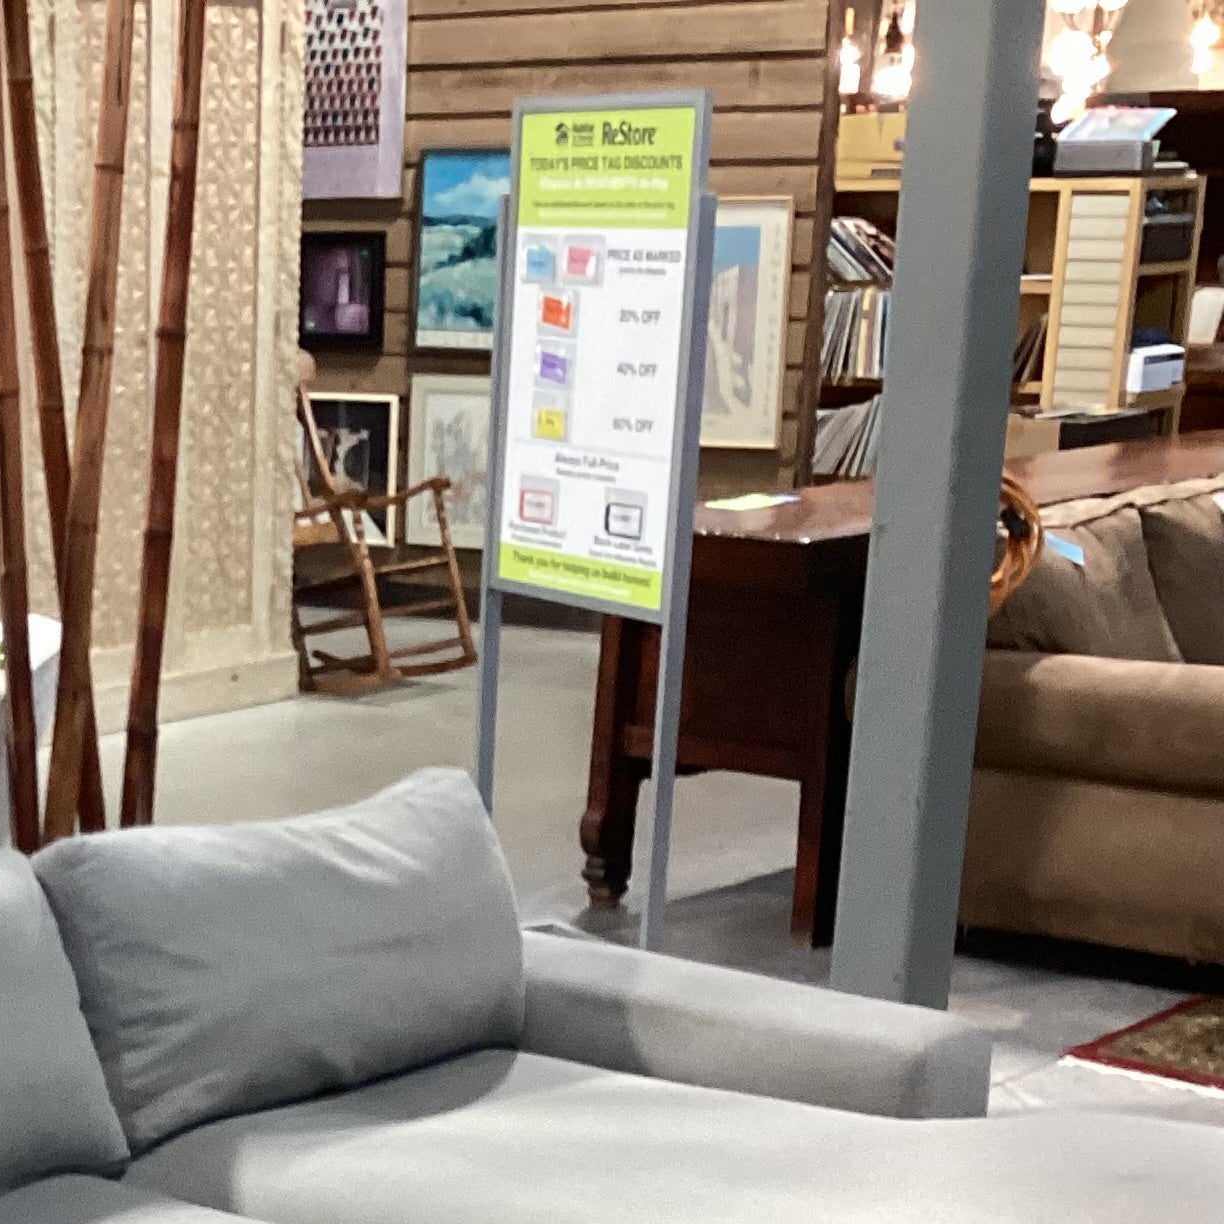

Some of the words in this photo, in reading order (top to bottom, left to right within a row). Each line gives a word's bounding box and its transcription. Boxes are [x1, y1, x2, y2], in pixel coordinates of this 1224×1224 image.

[602, 121, 656, 146] ReStore
[530, 157, 569, 171] TODAY'S
[572, 156, 599, 170] PRICE
[602, 156, 622, 170] TAG
[624, 155, 683, 170] DISCOUNTS
[608, 249, 630, 261] PRICE
[633, 250, 643, 261] AS
[646, 250, 681, 263] MARKED
[642, 311, 661, 324] OFF
[617, 362, 637, 376] 40%
[639, 363, 657, 377] OFF
[635, 420, 654, 433] OFF
[513, 550, 534, 564] Thank
[536, 557, 550, 568] you
[550, 558, 561, 570] for
[563, 562, 589, 578] helping
